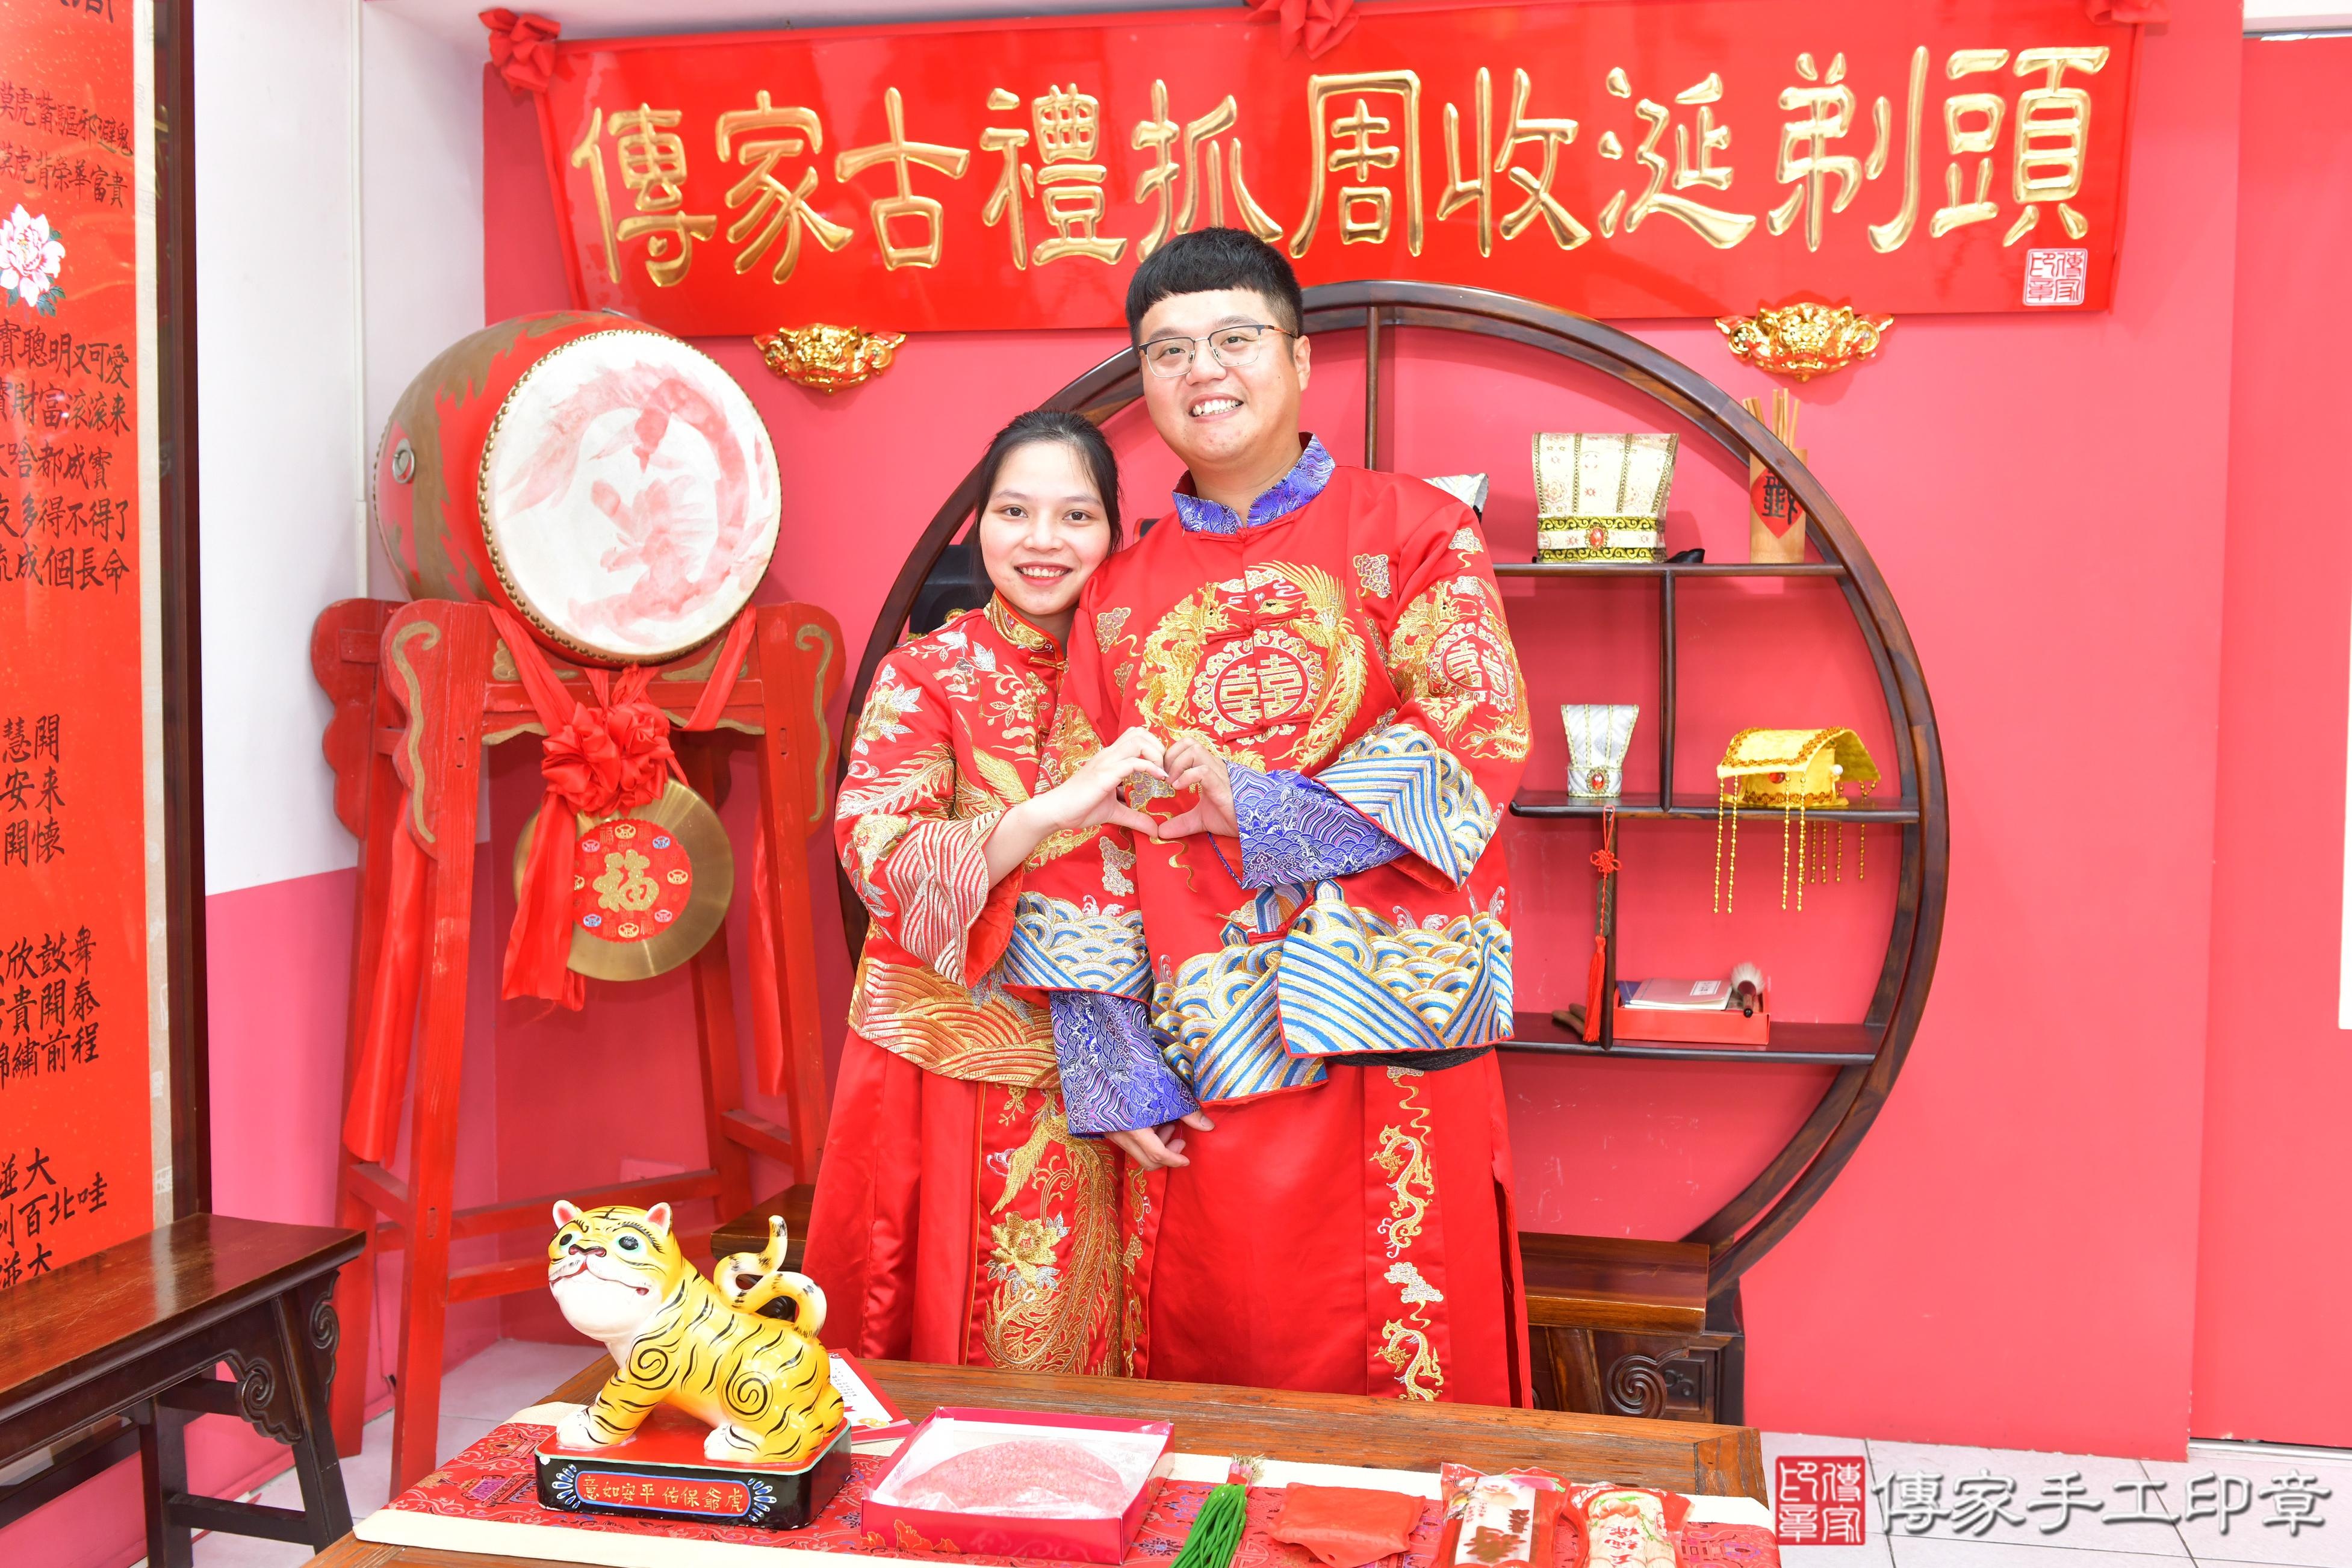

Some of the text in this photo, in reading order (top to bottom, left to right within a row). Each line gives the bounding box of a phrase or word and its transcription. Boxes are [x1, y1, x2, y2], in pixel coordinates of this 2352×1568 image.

[571, 46, 2110, 288] 傳家古禮抓周收涎剃頭
[592, 849, 659, 913] 福
[0, 925, 96, 987] 欣鼓舞
[0, 978, 101, 1031] 貴開泰
